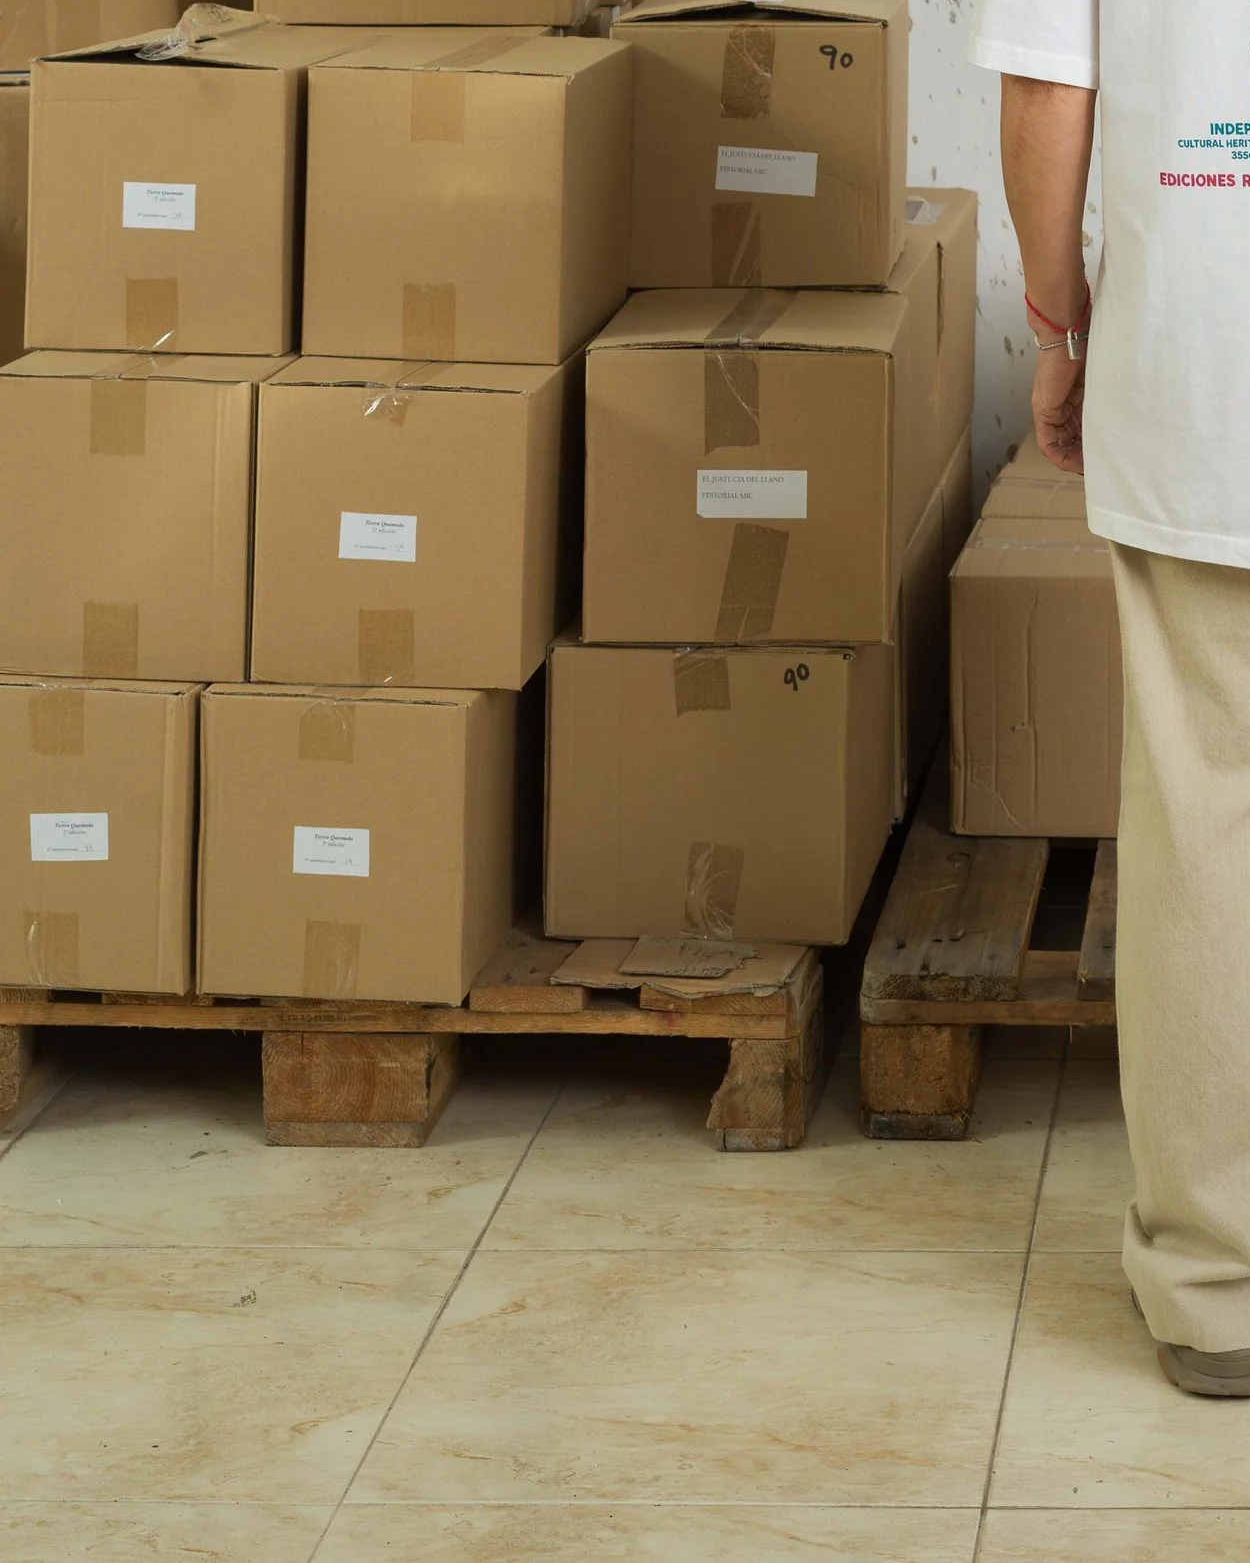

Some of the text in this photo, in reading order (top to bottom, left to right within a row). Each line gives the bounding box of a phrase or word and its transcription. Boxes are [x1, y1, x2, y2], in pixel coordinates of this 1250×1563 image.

[819, 44, 853, 70] 90
[1178, 139, 1224, 148] CULTURAL
[1159, 172, 1236, 187] EDICIONES
[783, 663, 810, 691] 90
